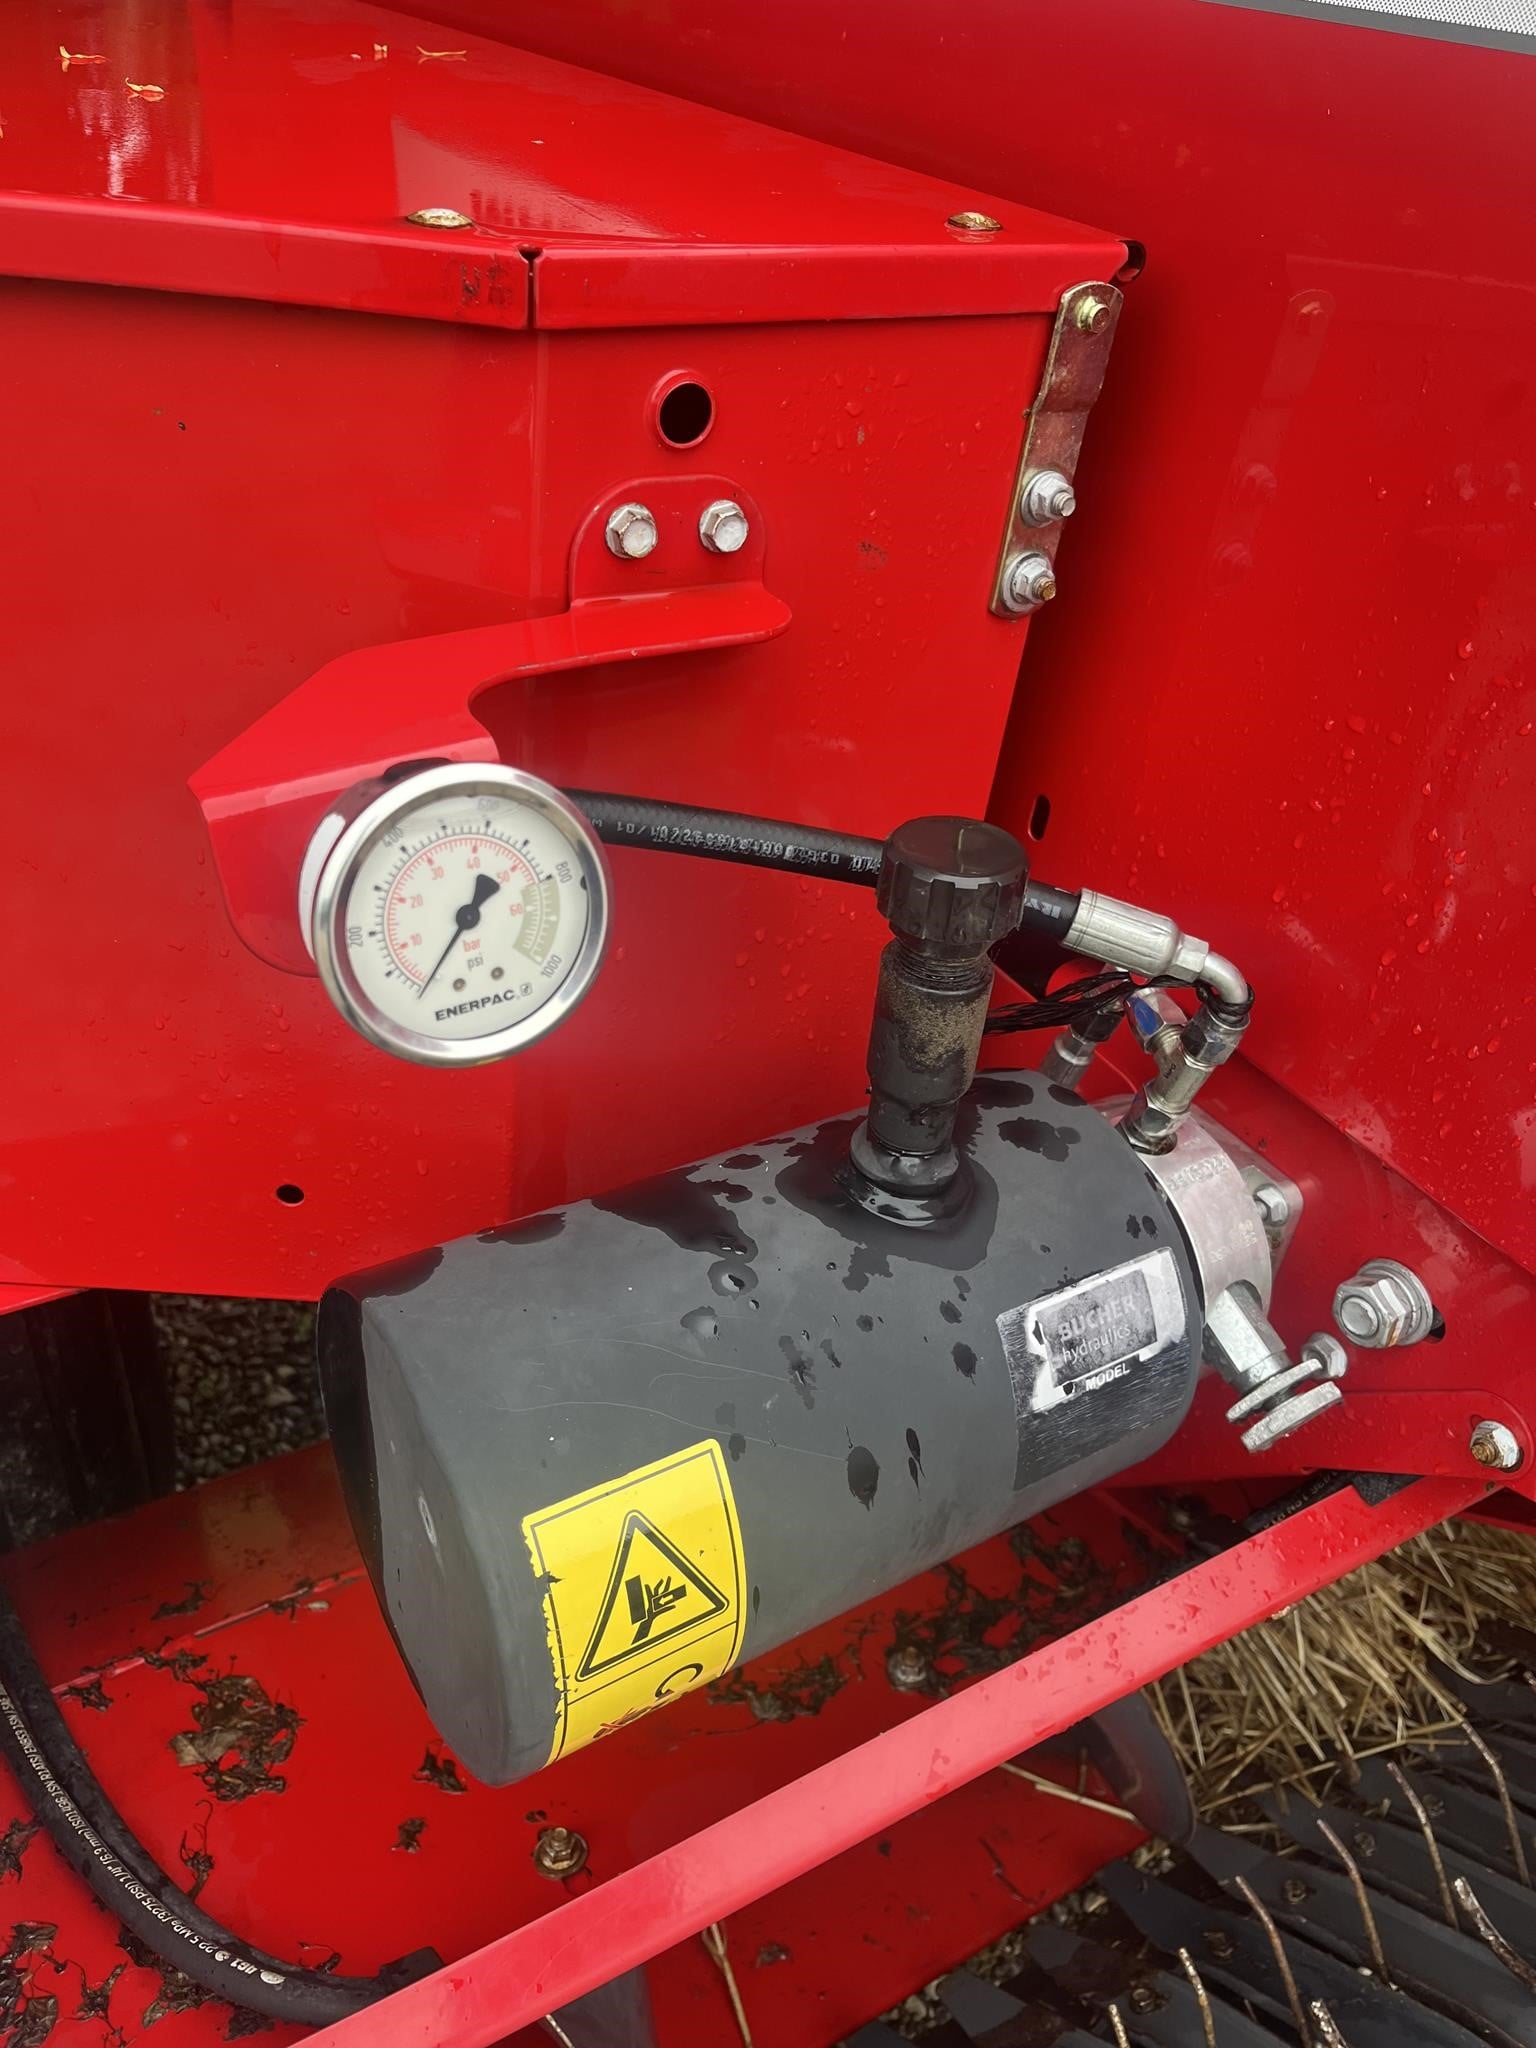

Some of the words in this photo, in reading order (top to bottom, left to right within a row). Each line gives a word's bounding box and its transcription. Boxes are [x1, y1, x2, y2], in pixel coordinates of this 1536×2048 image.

[382, 827, 404, 849] 400
[432, 867, 444, 880] 30
[467, 858, 481, 870] 40
[554, 860, 573, 884] 800
[410, 895, 424, 908] 20
[510, 903, 524, 916] 60
[348, 926, 364, 948] 200
[410, 935, 423, 947] 10
[462, 939, 482, 953] bar
[467, 957, 484, 972] psi
[541, 955, 563, 979] 1000
[435, 989, 517, 1022] ENERPAC
[1058, 1296, 1135, 1342] BUCHER
[1062, 1323, 1132, 1363] hydraulics
[1085, 1363, 1131, 1391] MODEL
[170, 1919, 194, 1938] MPa
